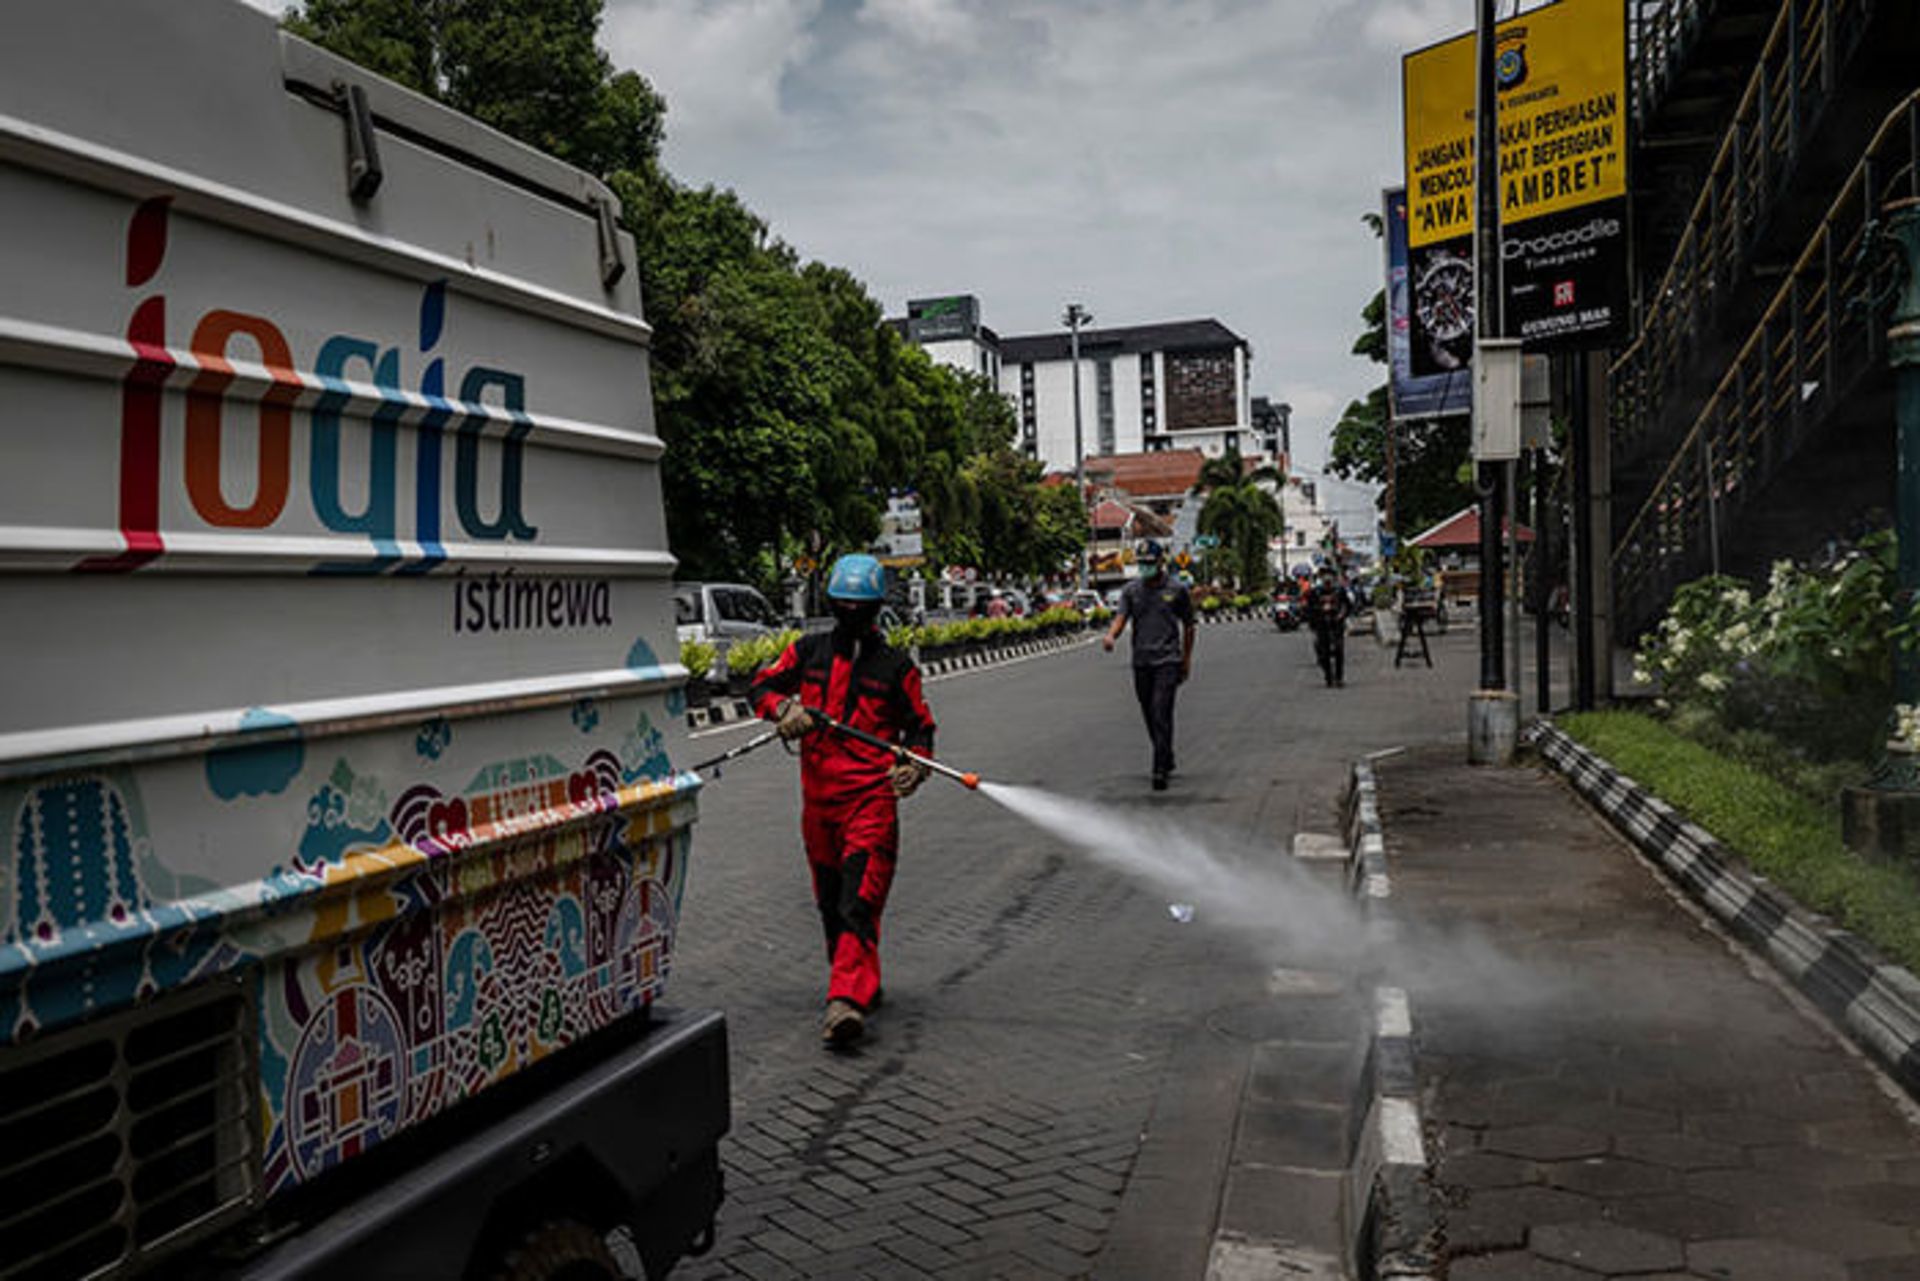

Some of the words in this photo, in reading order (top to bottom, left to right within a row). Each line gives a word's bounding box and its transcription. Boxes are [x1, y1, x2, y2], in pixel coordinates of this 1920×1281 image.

[1415, 136, 1466, 173] JANGAN
[1536, 92, 1617, 137] PERHIASAN
[1499, 147, 1527, 176] AAT
[1532, 124, 1613, 168] BEPERGIAN
[1415, 194, 1469, 232] "AWA
[1499, 218, 1620, 259] Crocodile
[455, 566, 612, 632] istimewa
